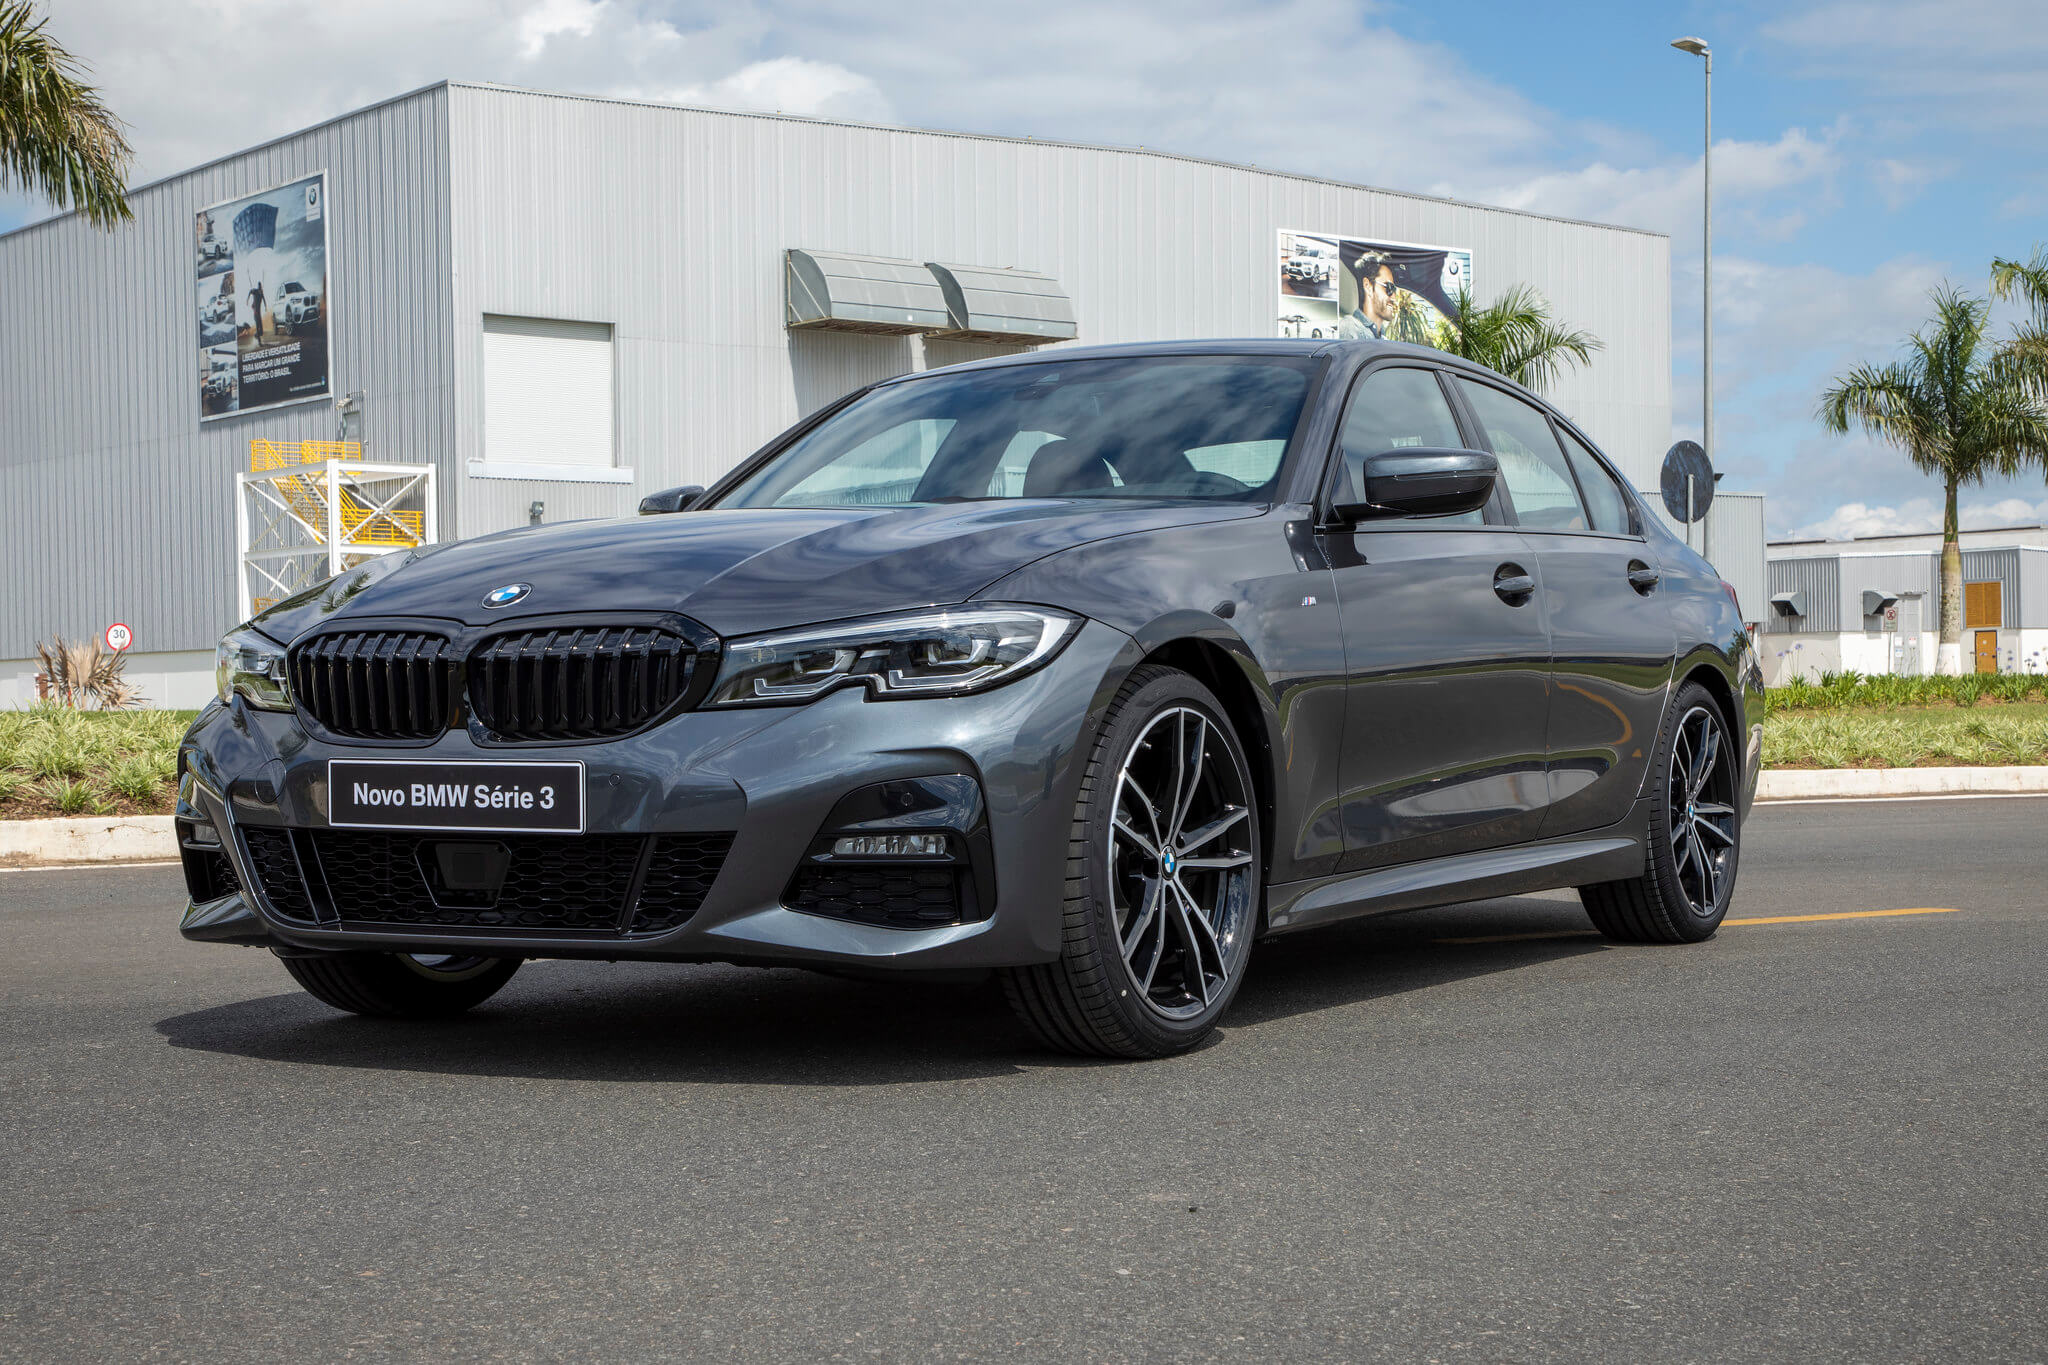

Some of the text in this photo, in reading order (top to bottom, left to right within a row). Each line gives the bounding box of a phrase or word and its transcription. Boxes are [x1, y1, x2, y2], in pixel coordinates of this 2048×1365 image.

[113, 629, 125, 639] 30
[353, 782, 555, 809] Novo BMW Série 3
